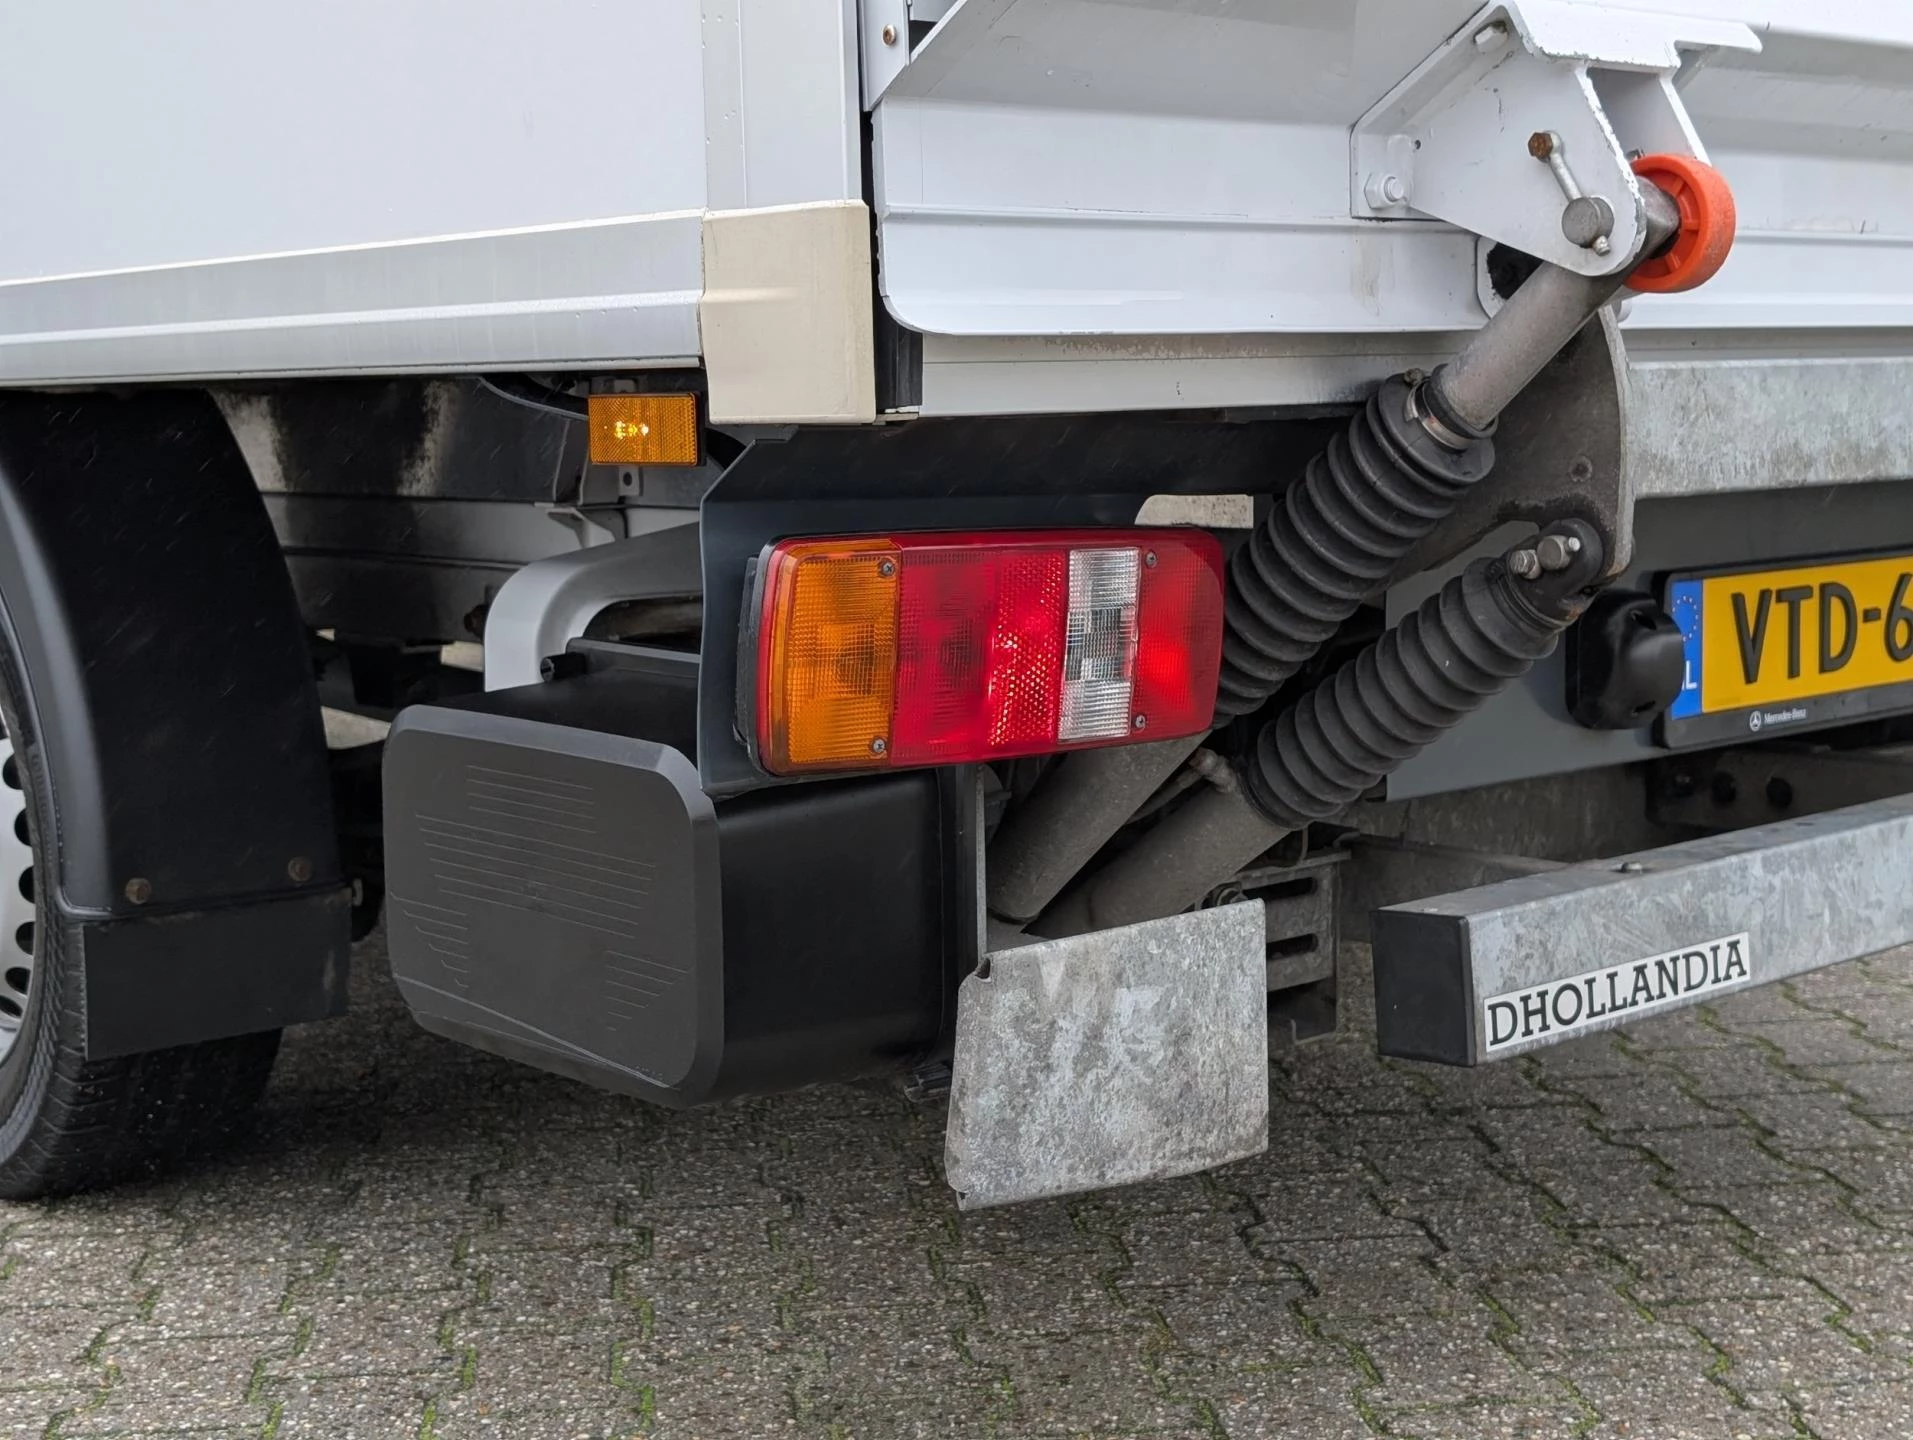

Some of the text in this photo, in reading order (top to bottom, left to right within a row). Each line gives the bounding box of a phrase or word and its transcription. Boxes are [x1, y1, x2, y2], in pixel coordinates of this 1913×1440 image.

[1681, 660, 1697, 690] L
[1731, 572, 1913, 685] VTD-6
[1487, 939, 1747, 1046] DHOLLANDIA
